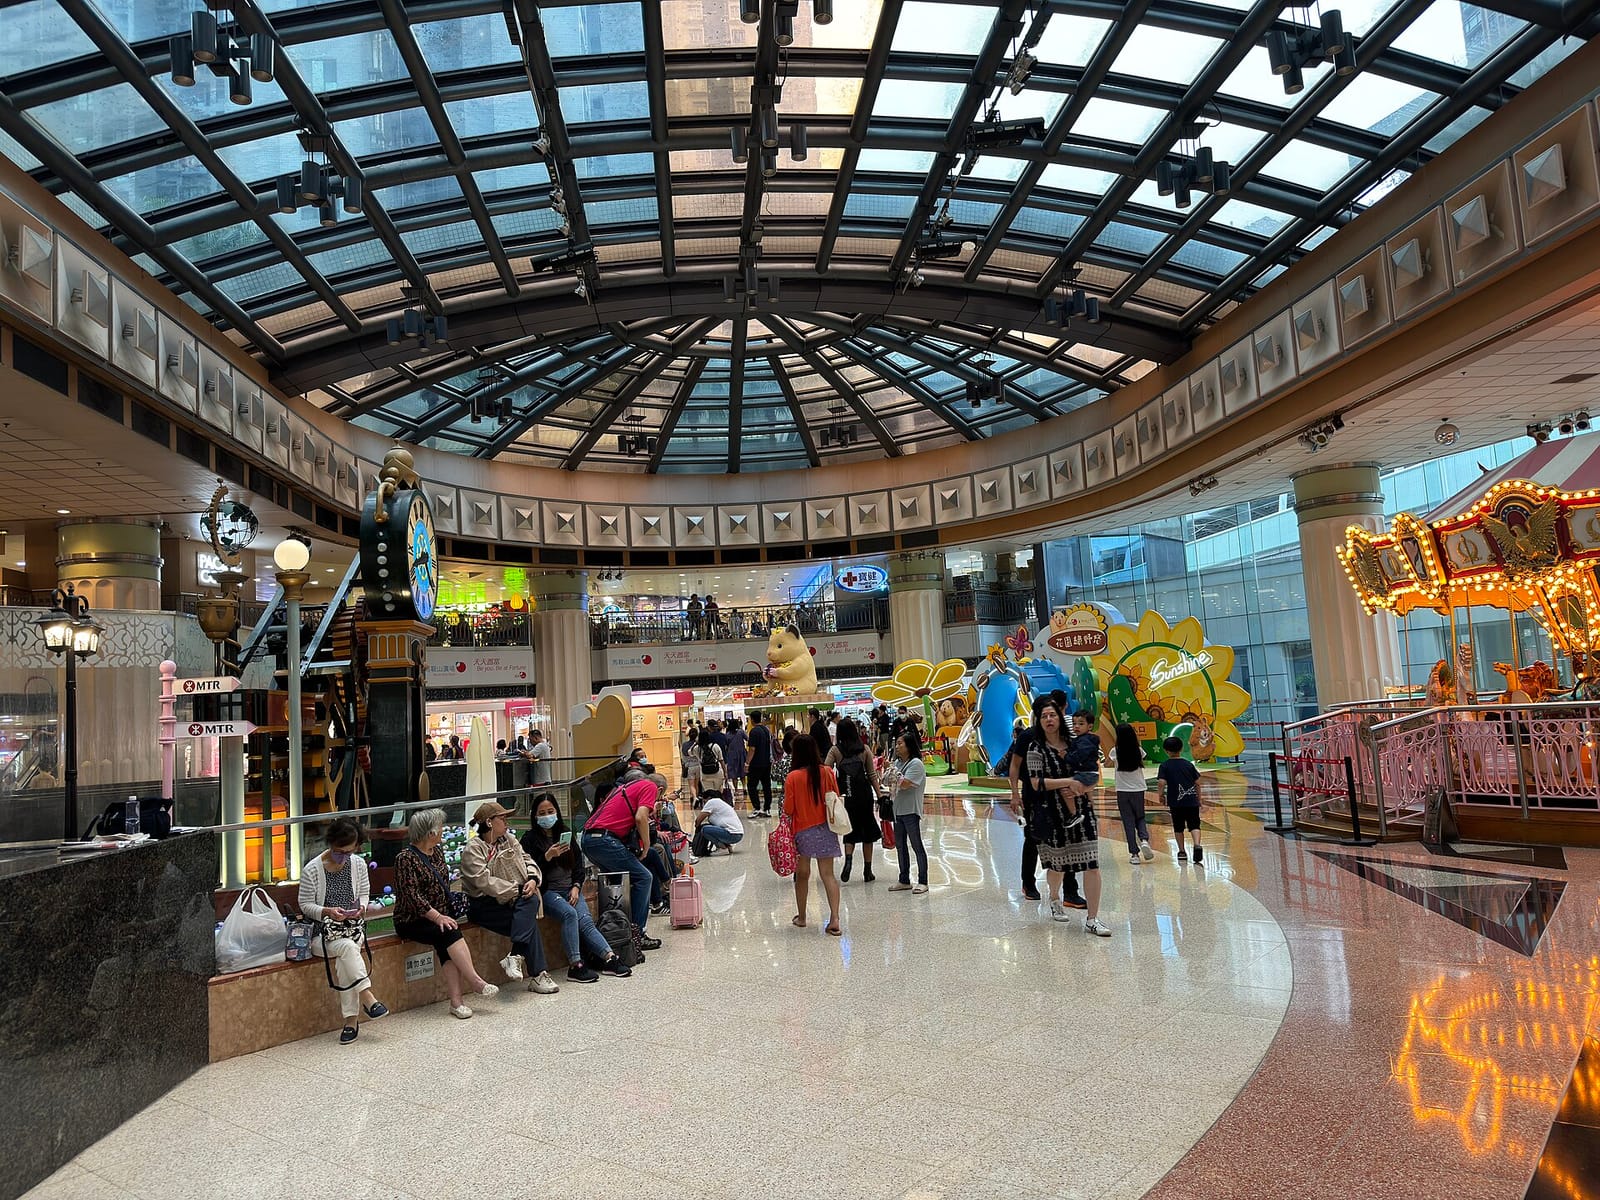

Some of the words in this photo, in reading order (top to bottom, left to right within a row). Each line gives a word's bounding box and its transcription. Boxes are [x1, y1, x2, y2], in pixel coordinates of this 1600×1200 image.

[1150, 652, 1210, 688] Sunshine
[196, 681, 220, 690] MTR
[205, 724, 234, 734] MTR
